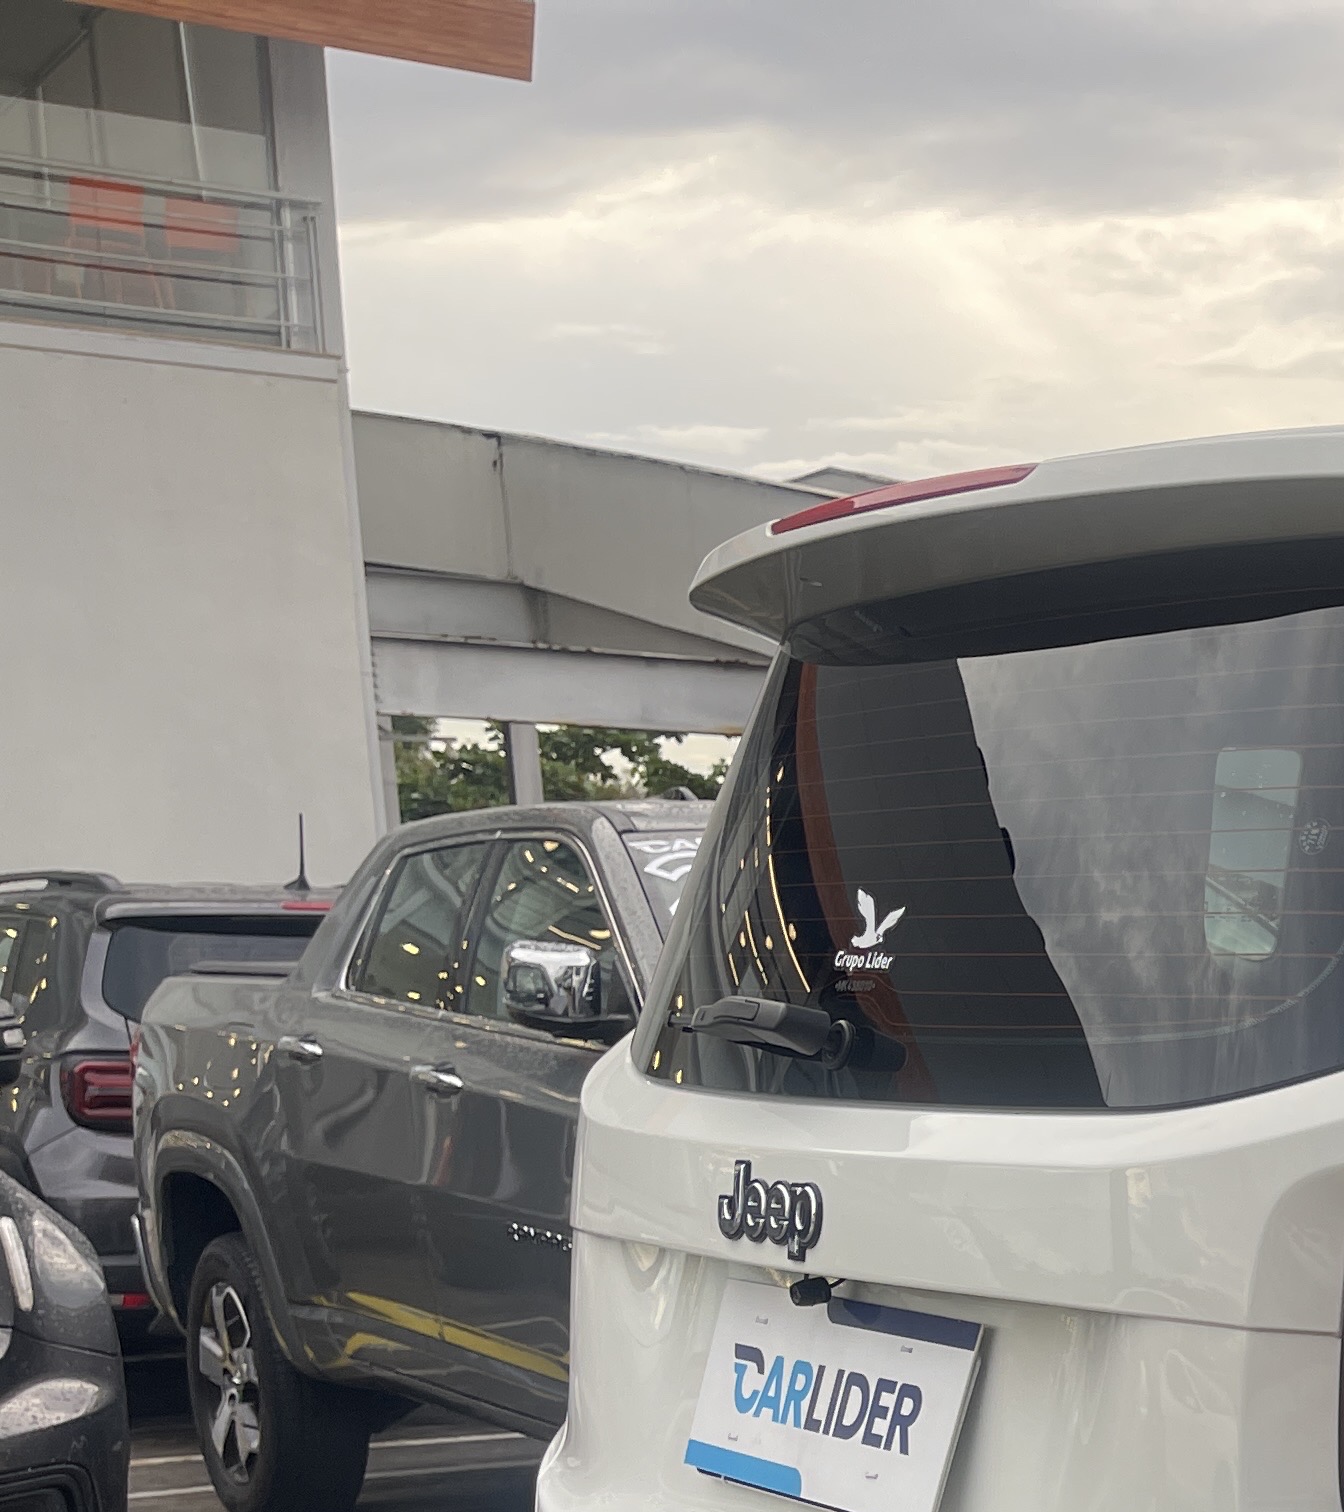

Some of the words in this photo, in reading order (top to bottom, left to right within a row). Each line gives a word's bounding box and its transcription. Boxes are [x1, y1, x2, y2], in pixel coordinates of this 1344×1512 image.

[628, 836, 702, 853] CA
[834, 950, 865, 972] Grupo
[718, 1159, 824, 1262] Jeep
[733, 1343, 923, 1456] CARLIDER
